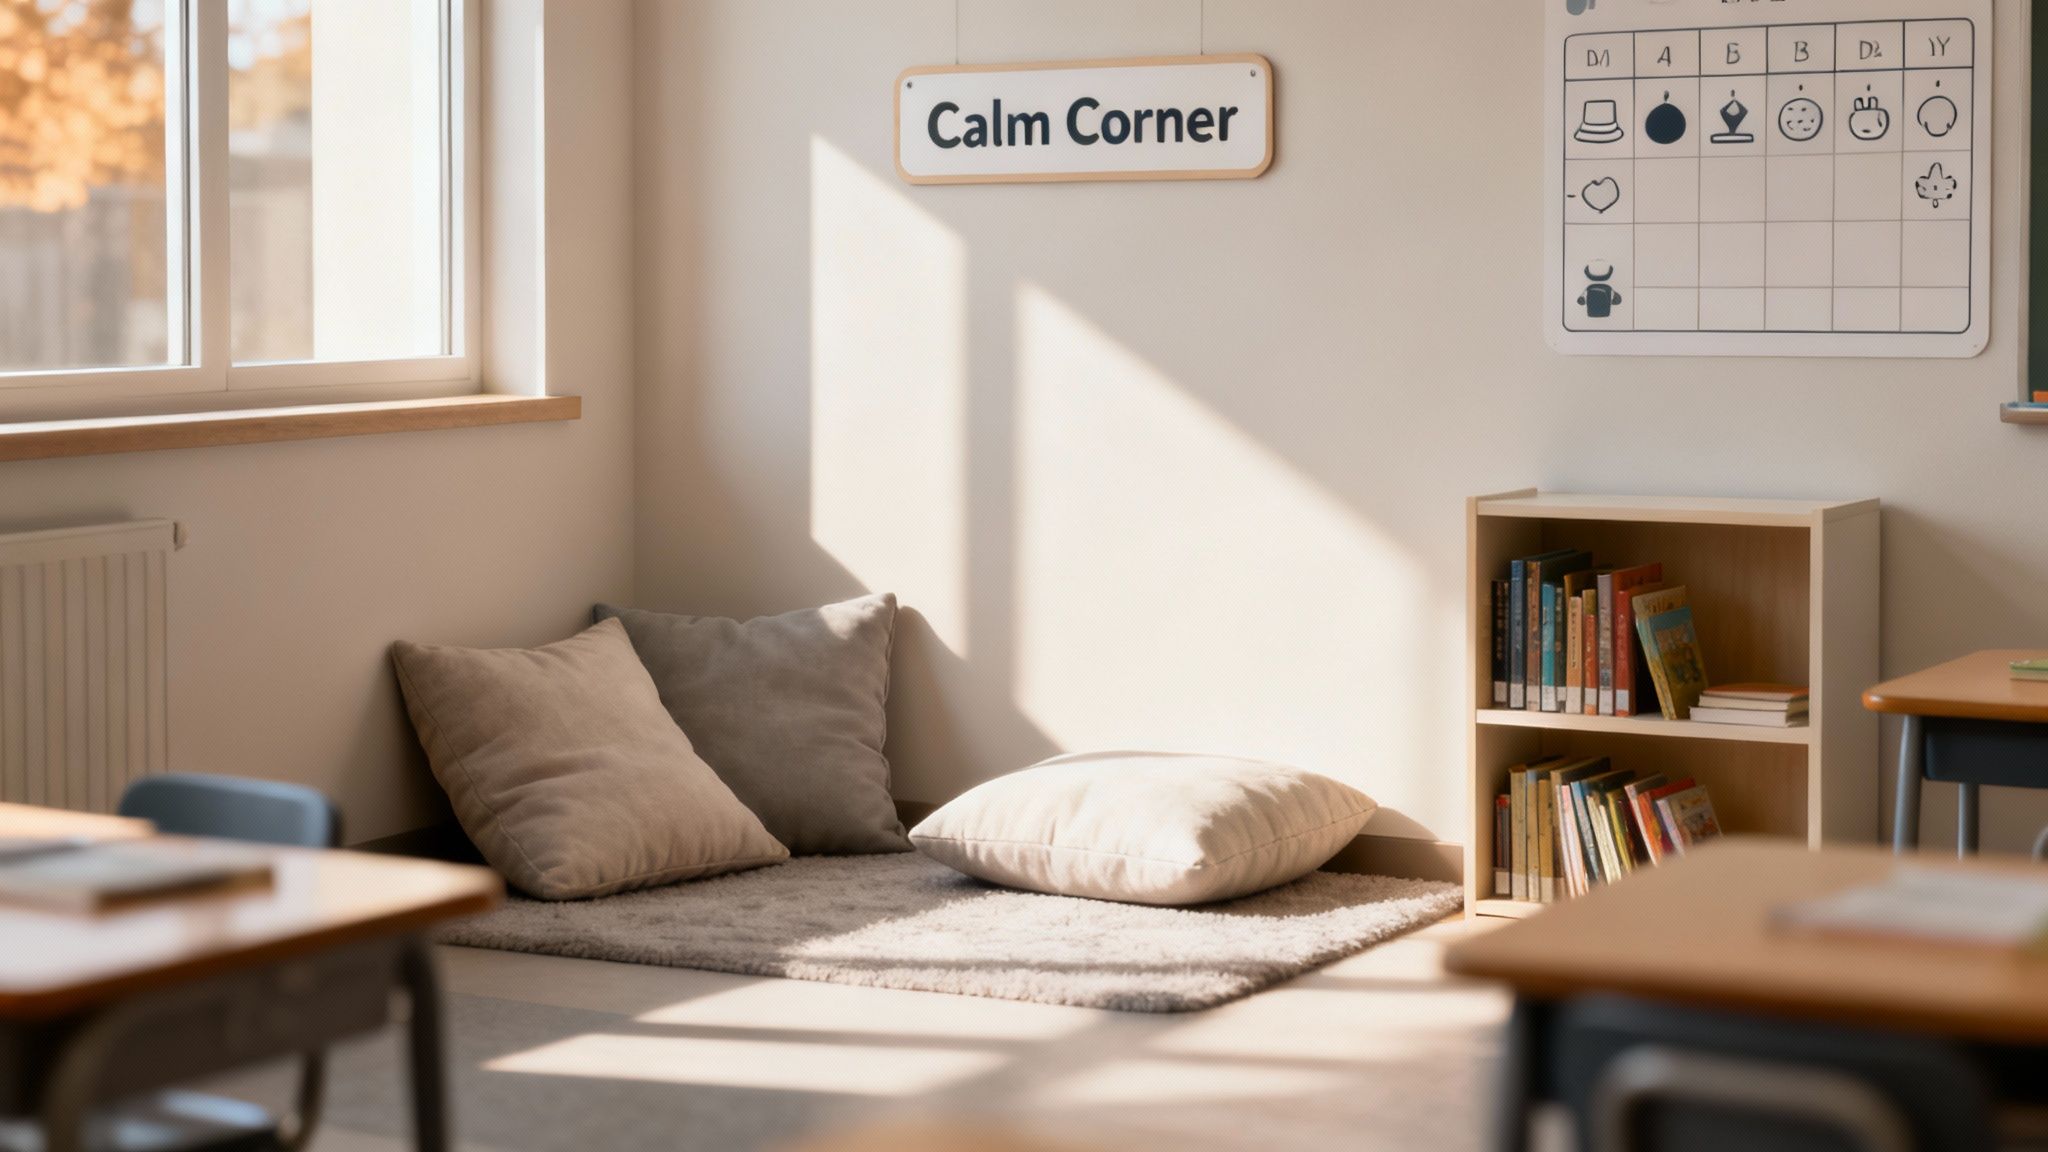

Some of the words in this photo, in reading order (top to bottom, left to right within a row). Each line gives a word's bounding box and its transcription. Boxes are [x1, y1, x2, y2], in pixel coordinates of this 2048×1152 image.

[1657, 46, 1671, 67] A
[1794, 41, 1809, 62] B
[928, 98, 1050, 149] Calm
[1066, 97, 1239, 146] Corner
